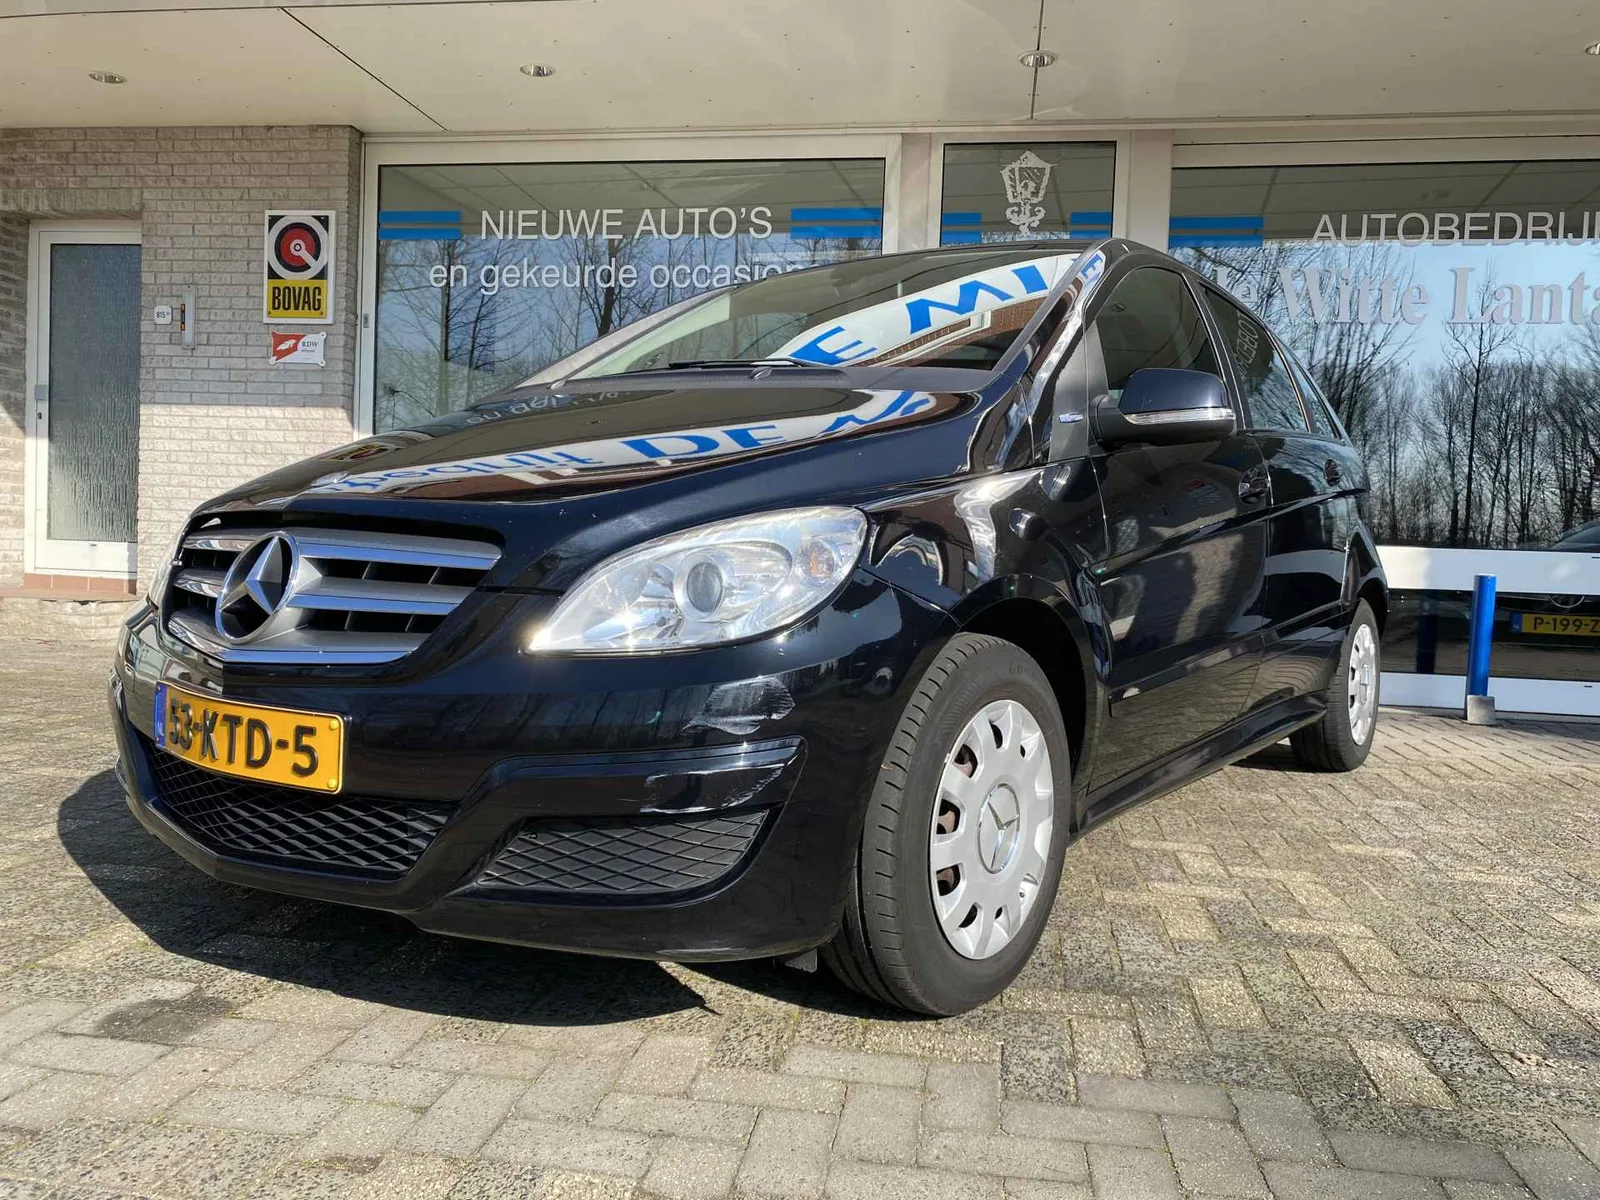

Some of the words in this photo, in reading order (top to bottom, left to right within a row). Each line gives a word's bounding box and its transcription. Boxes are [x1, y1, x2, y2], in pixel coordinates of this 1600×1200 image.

[481, 209, 623, 240] NIEUWE
[633, 206, 773, 240] AUTO'S
[1312, 211, 1600, 247] AUTOBEDRIJ
[429, 264, 468, 287] en
[480, 257, 638, 296] gekeurde
[650, 257, 819, 288] occasi
[272, 286, 322, 311] BOVAG
[1279, 266, 1428, 325] Witte
[1449, 266, 1600, 325] Lant
[169, 698, 319, 778] 53-KTD-5
